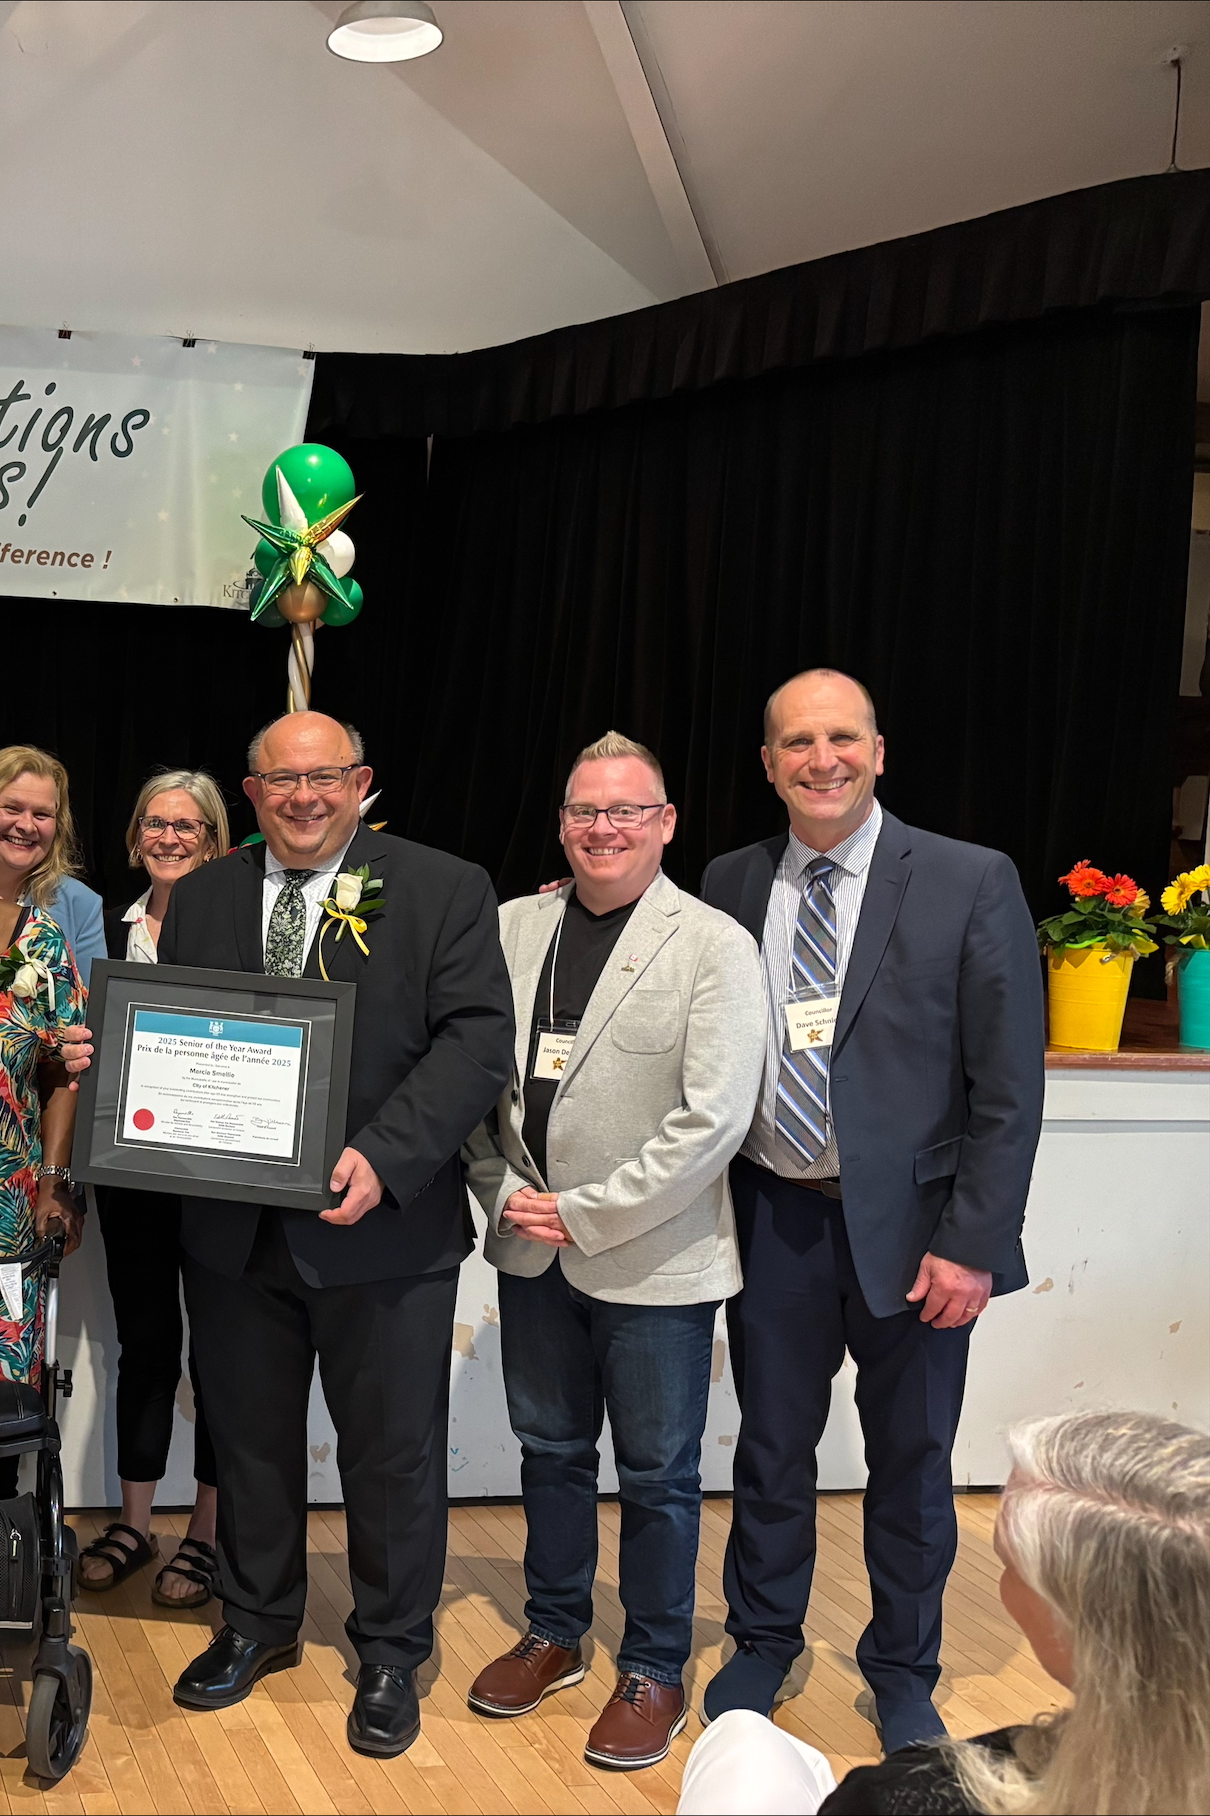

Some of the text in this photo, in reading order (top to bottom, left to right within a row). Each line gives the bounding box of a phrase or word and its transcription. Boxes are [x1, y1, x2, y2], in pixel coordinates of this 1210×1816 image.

[804, 1007, 833, 1016] Councillor
[795, 1021, 814, 1029] Dave
[158, 1036, 272, 1056] 2025 Senior of the Year Award
[137, 1044, 152, 1053] Prix
[153, 1045, 164, 1054] de
[165, 1046, 173, 1055] la
[173, 1049, 209, 1058] personne
[210, 1051, 229, 1062] âgée
[230, 1053, 240, 1062] de
[271, 1058, 292, 1067] 2025
[189, 1068, 235, 1078] Marcia Smellie
